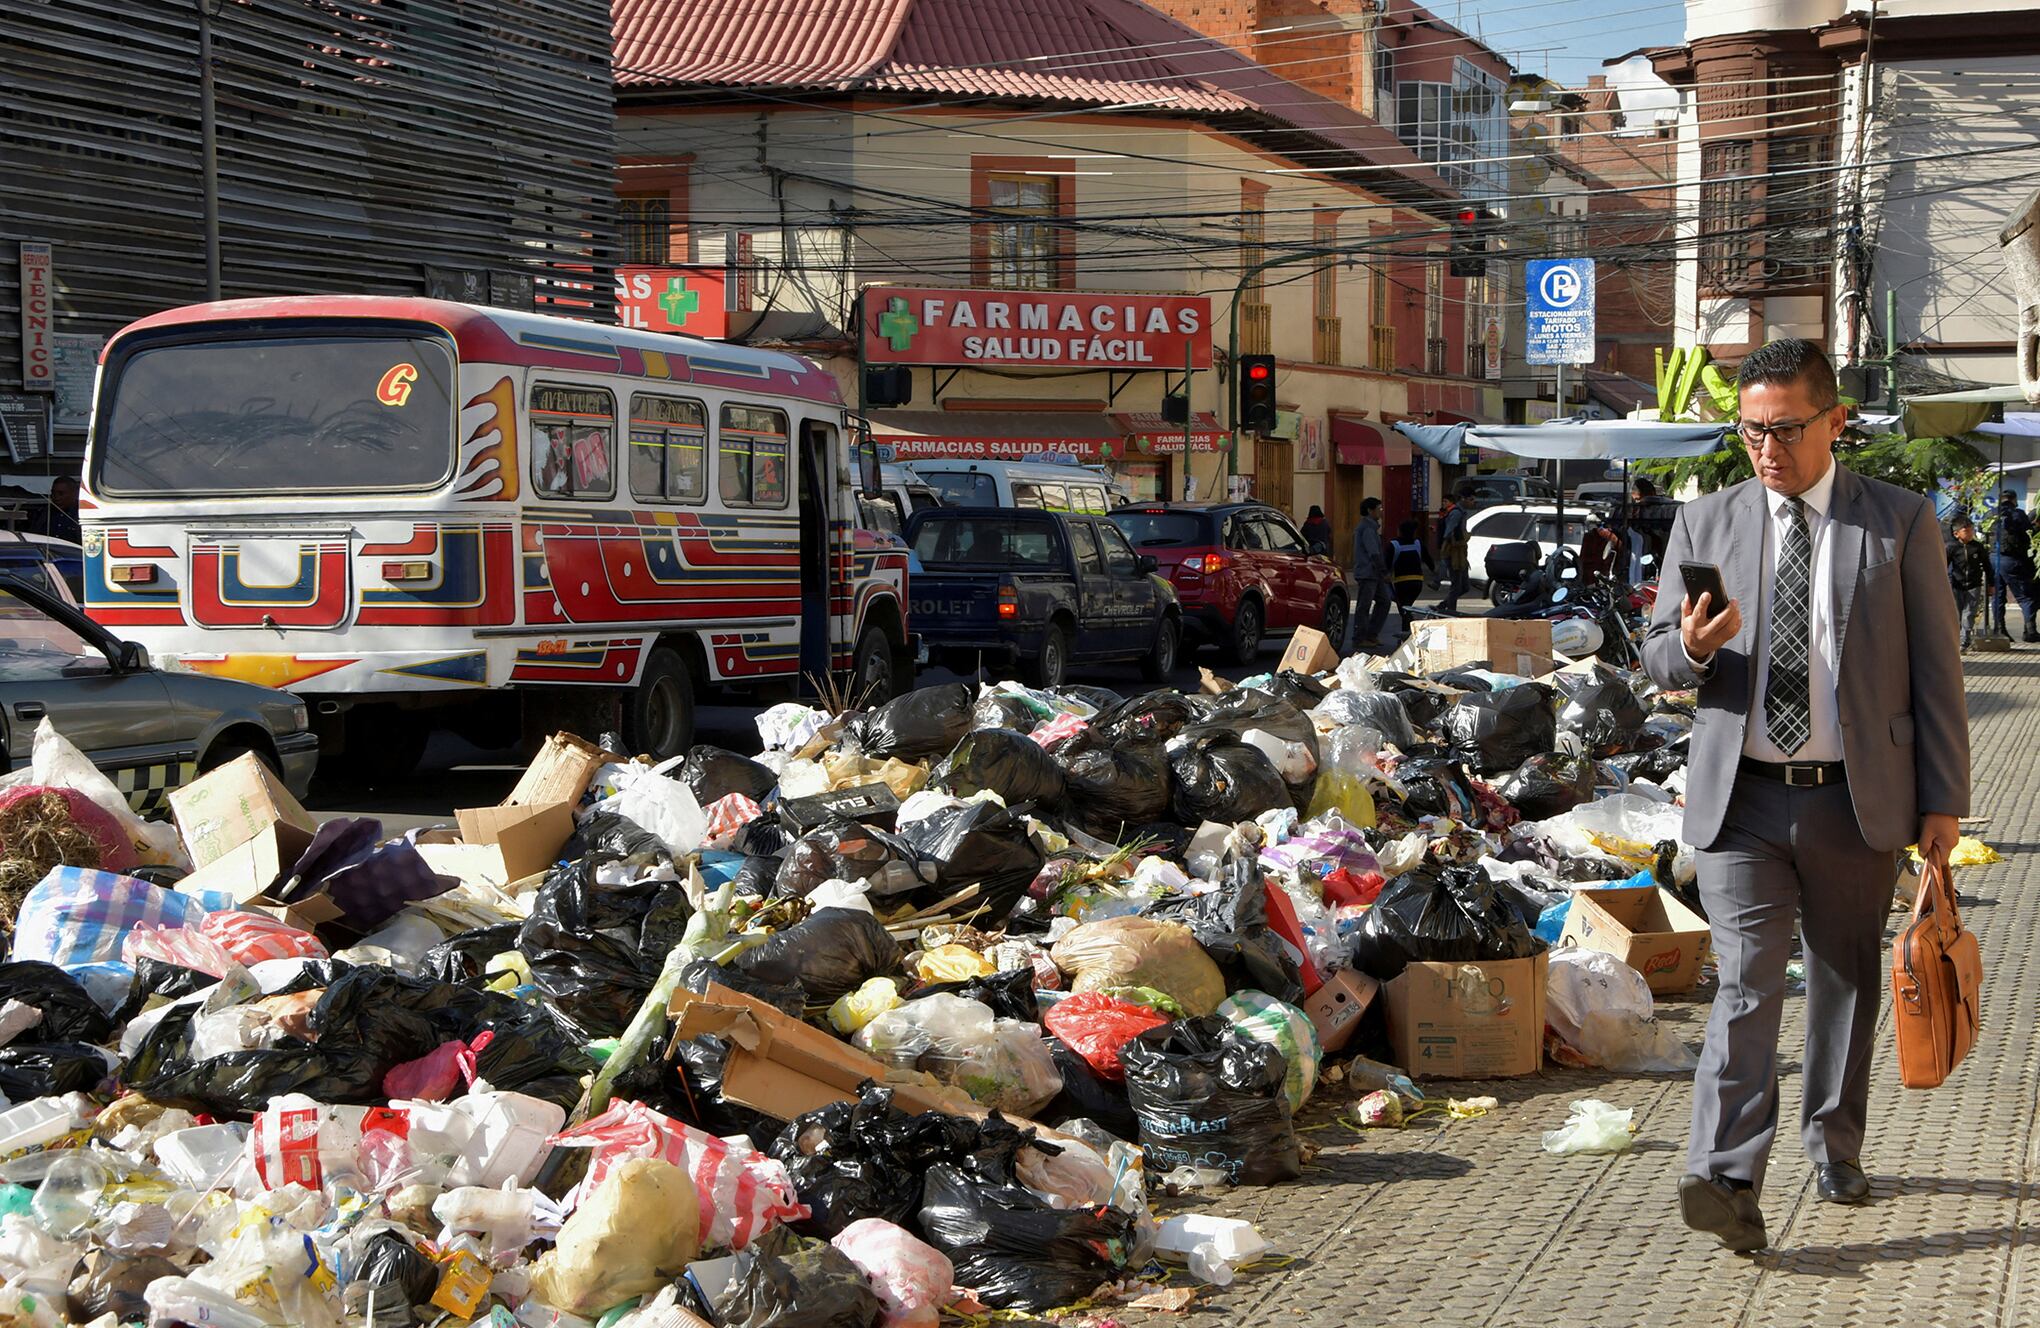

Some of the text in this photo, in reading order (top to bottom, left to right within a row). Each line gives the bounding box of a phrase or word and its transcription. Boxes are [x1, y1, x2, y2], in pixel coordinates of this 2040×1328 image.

[923, 299, 1200, 334] FARMACIAS
[1529, 310, 1592, 318] ESTACIONAMIENTO
[28, 267, 49, 378] TECNICO
[1541, 324, 1581, 333] MOTOS
[964, 334, 1153, 362] SALUD FÁCIL
[377, 363, 418, 406] G
[892, 439, 1094, 454] FARMACIAS SALUD FÁCIL
[1042, 451, 1056, 463] 40
[910, 600, 976, 614] ROLET
[1103, 604, 1145, 616] CHEVROLET
